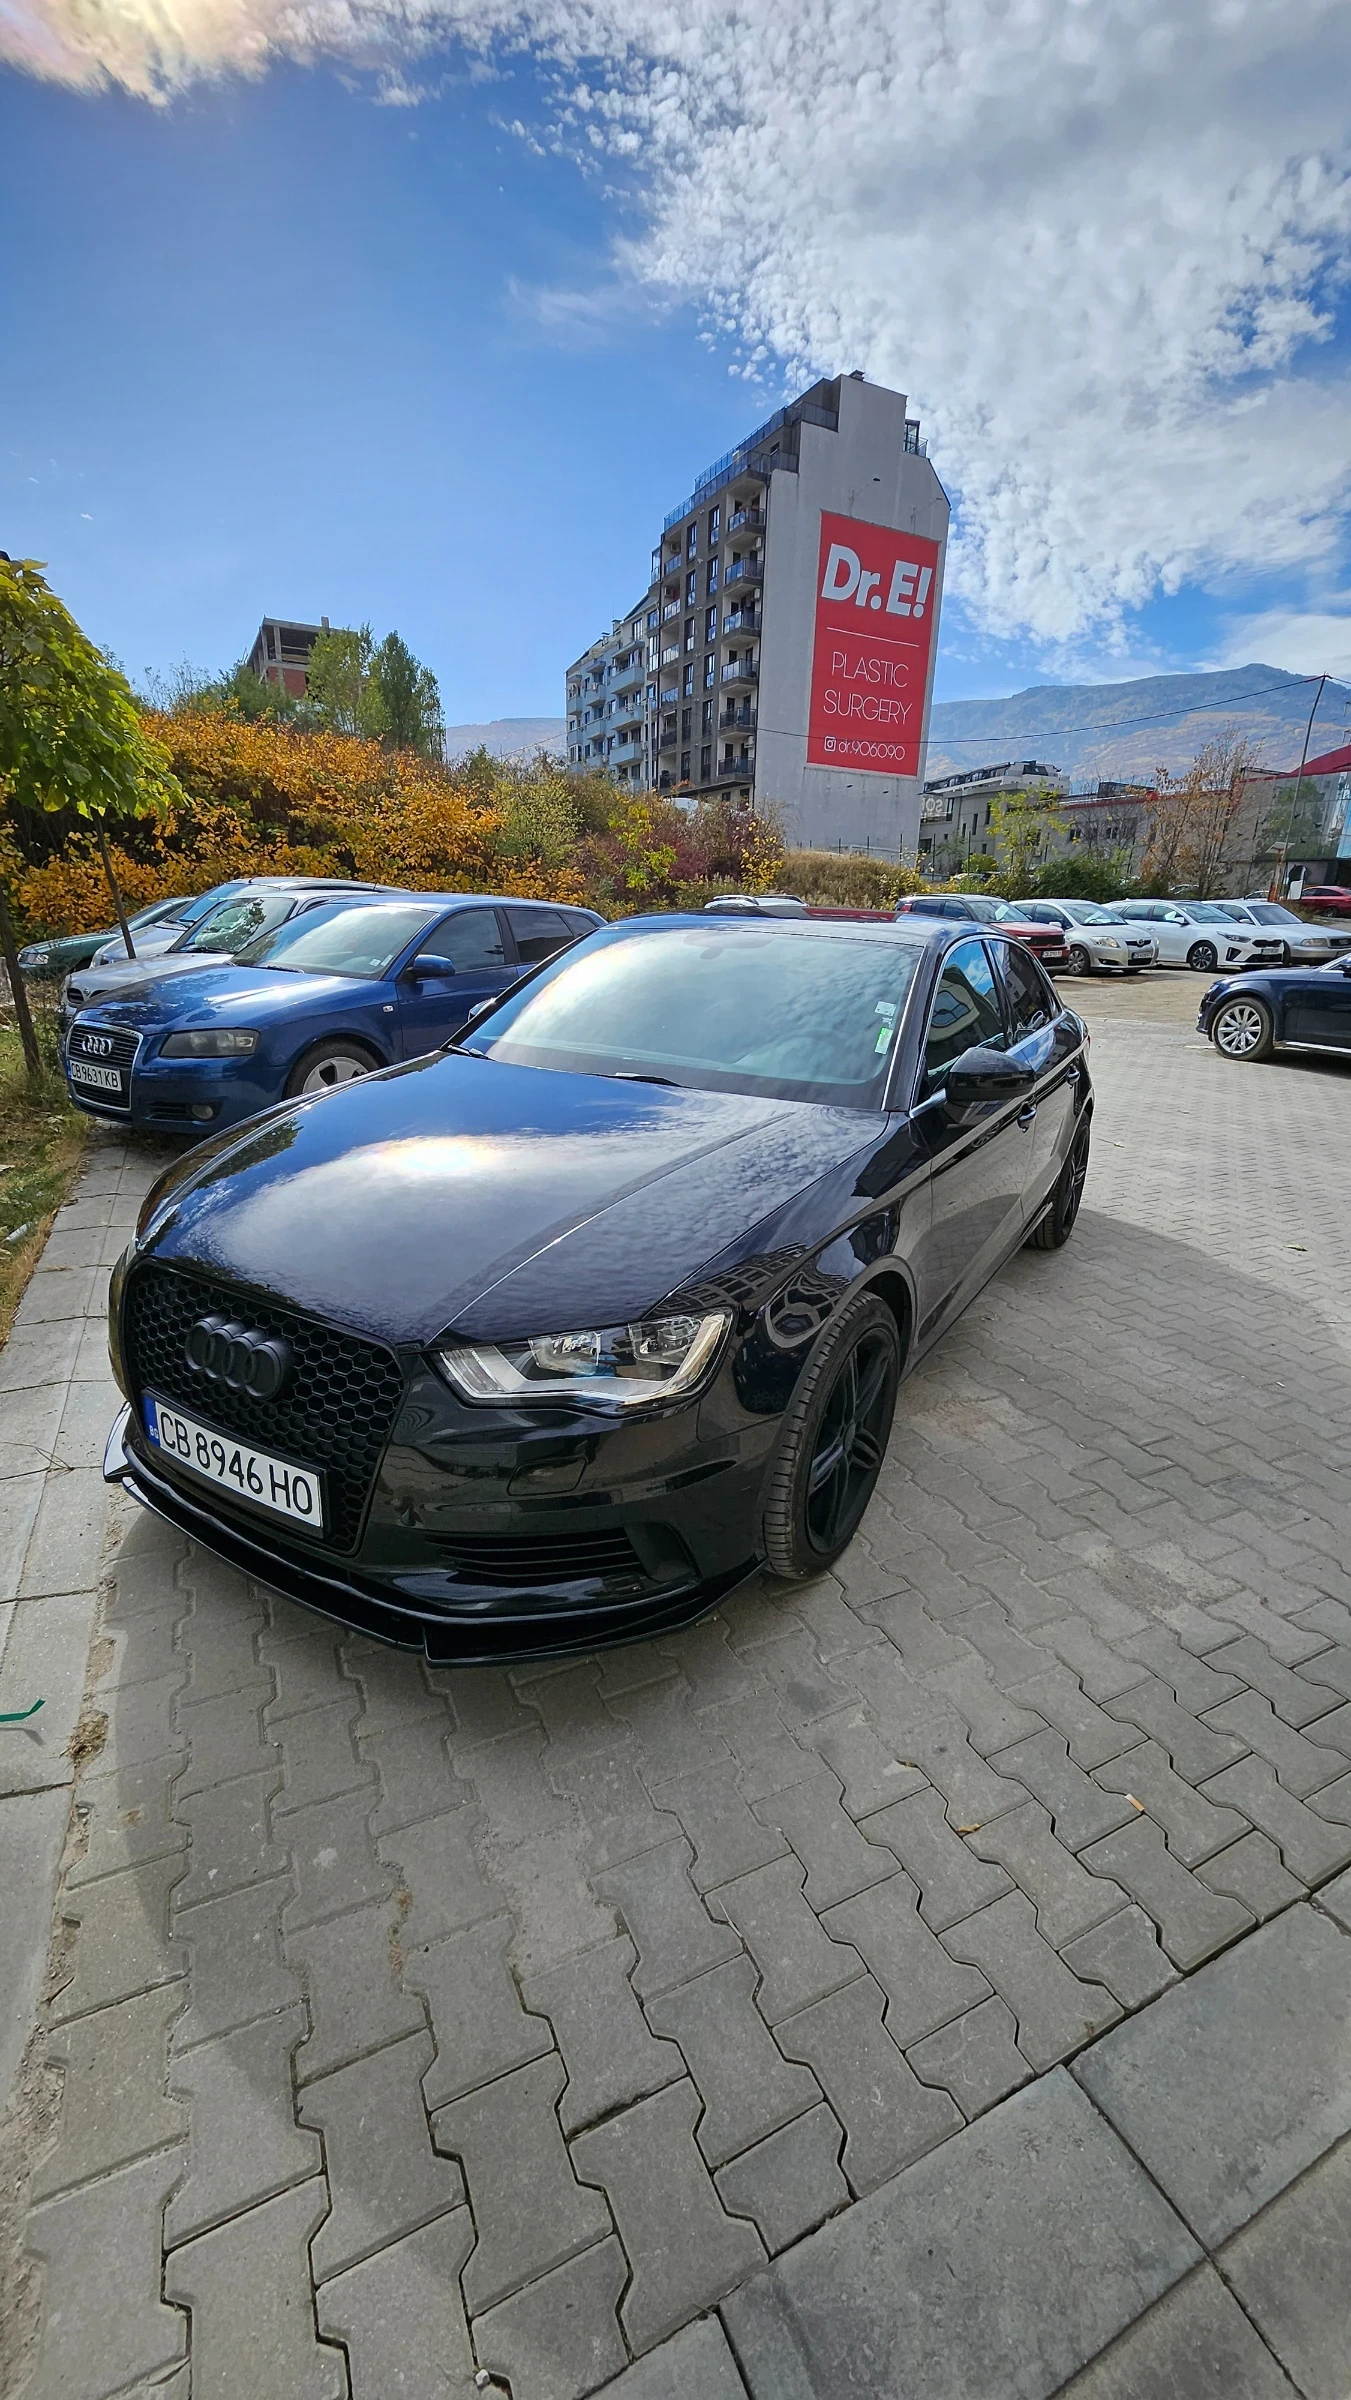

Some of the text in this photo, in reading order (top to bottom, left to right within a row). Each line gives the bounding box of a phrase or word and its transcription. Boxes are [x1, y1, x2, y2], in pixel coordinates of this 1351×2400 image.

[821, 543, 933, 618] Dr.E!
[831, 651, 909, 688] PLASTIC
[823, 689, 913, 725] SURGERY
[838, 739, 906, 761] dr.906090
[71, 1062, 82, 1079] CB
[82, 1065, 103, 1085] 9631
[104, 1070, 119, 1088] KB
[149, 1424, 160, 1440] BG
[160, 1411, 313, 1515] CB 8946 HO
